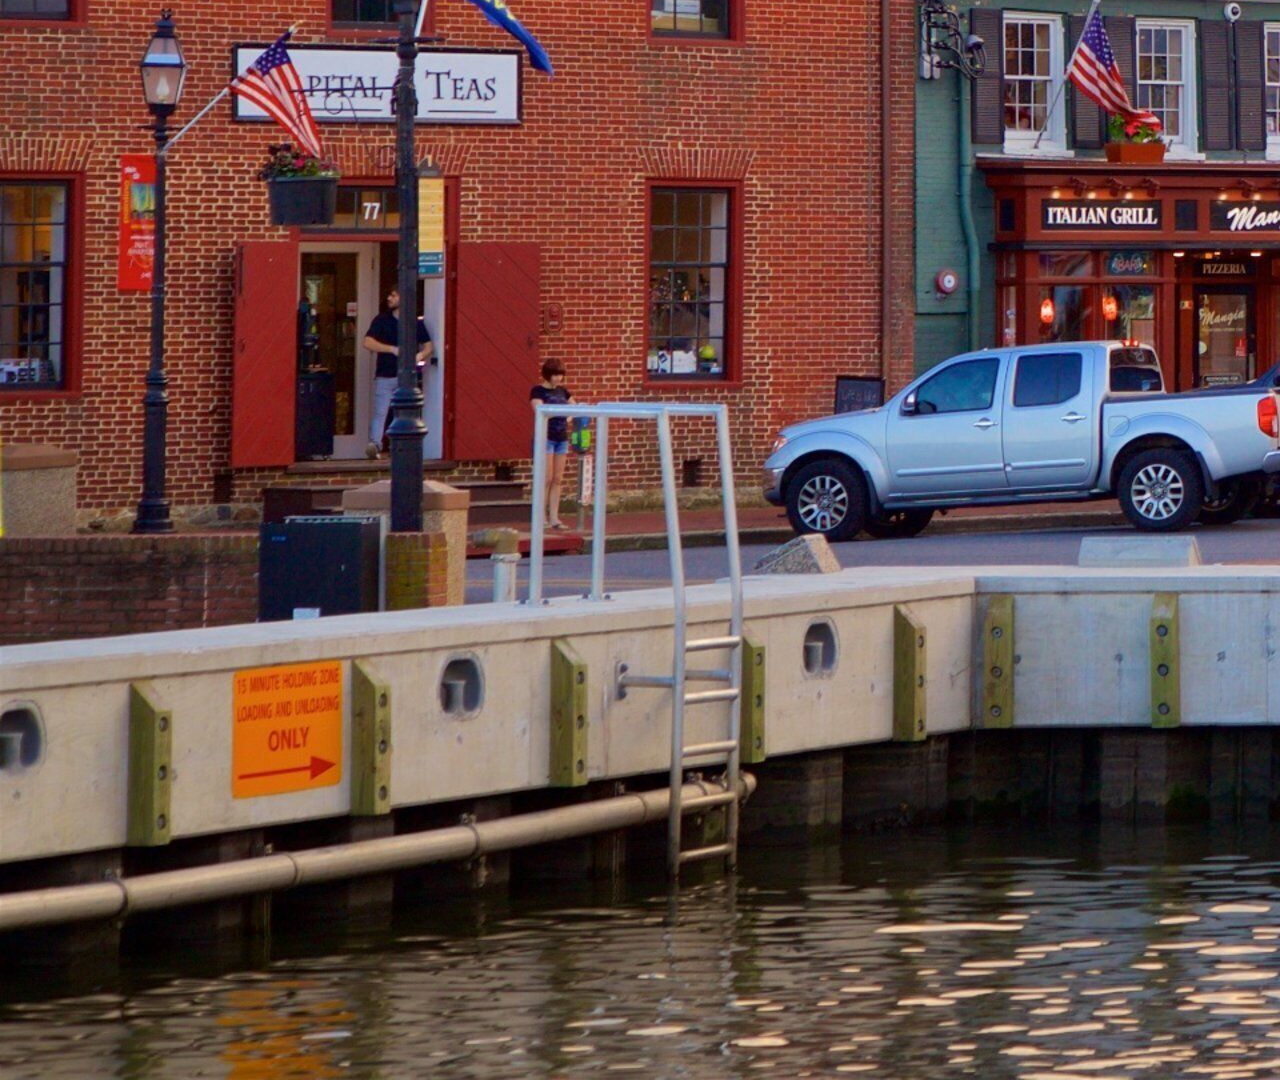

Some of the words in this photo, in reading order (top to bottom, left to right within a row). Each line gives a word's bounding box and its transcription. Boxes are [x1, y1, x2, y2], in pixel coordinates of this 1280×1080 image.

[306, 75, 382, 99] PITAL
[362, 202, 381, 221] 77
[1047, 207, 1108, 225] ITALIAN
[1110, 207, 1158, 225] GRILL
[1202, 263, 1246, 274] PIZZERIA
[1202, 308, 1246, 327] Mangia
[249, 674, 280, 693] MINUTE
[282, 670, 317, 689] HOLDING
[236, 702, 273, 722] LOADING
[275, 700, 292, 718] AND
[294, 695, 340, 716] UNLOADING
[268, 726, 310, 752] ONLY
